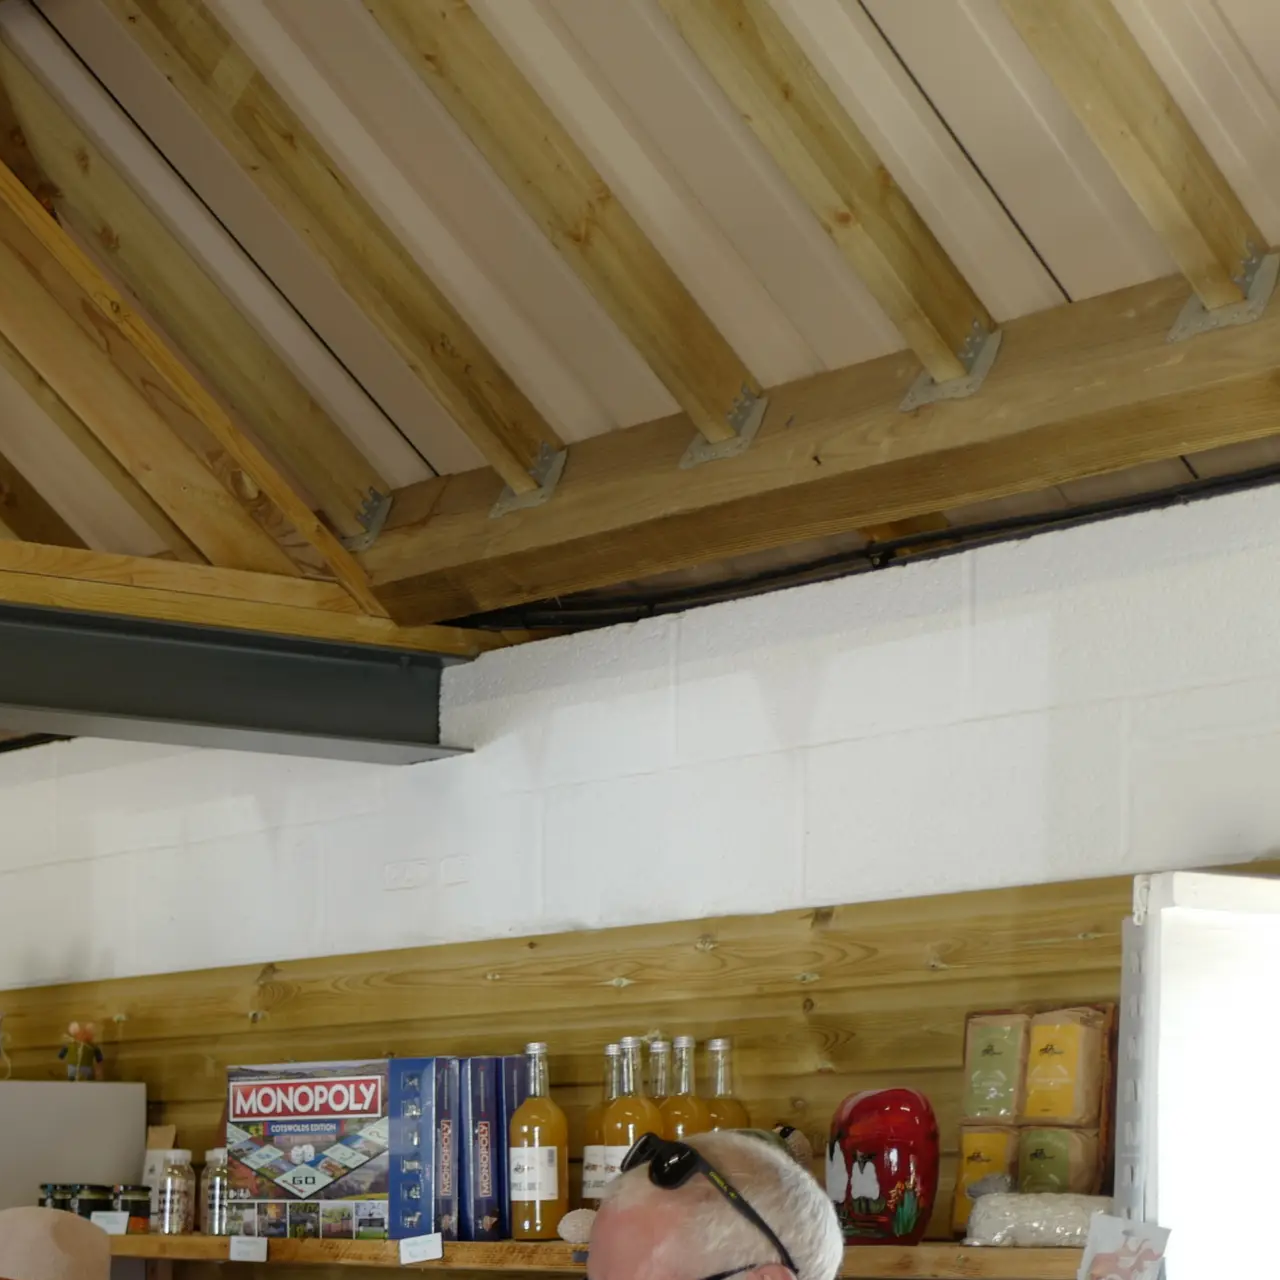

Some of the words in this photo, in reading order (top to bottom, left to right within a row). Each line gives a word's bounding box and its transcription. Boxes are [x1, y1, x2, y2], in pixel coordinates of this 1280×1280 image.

[235, 1082, 377, 1115] MONOPOLY
[270, 1122, 309, 1134] COTSWOLDS
[310, 1122, 337, 1133] EDITION
[441, 1121, 452, 1196] MONOPOLY
[479, 1122, 492, 1196] MONOPOLY
[291, 1175, 317, 1186] GO
